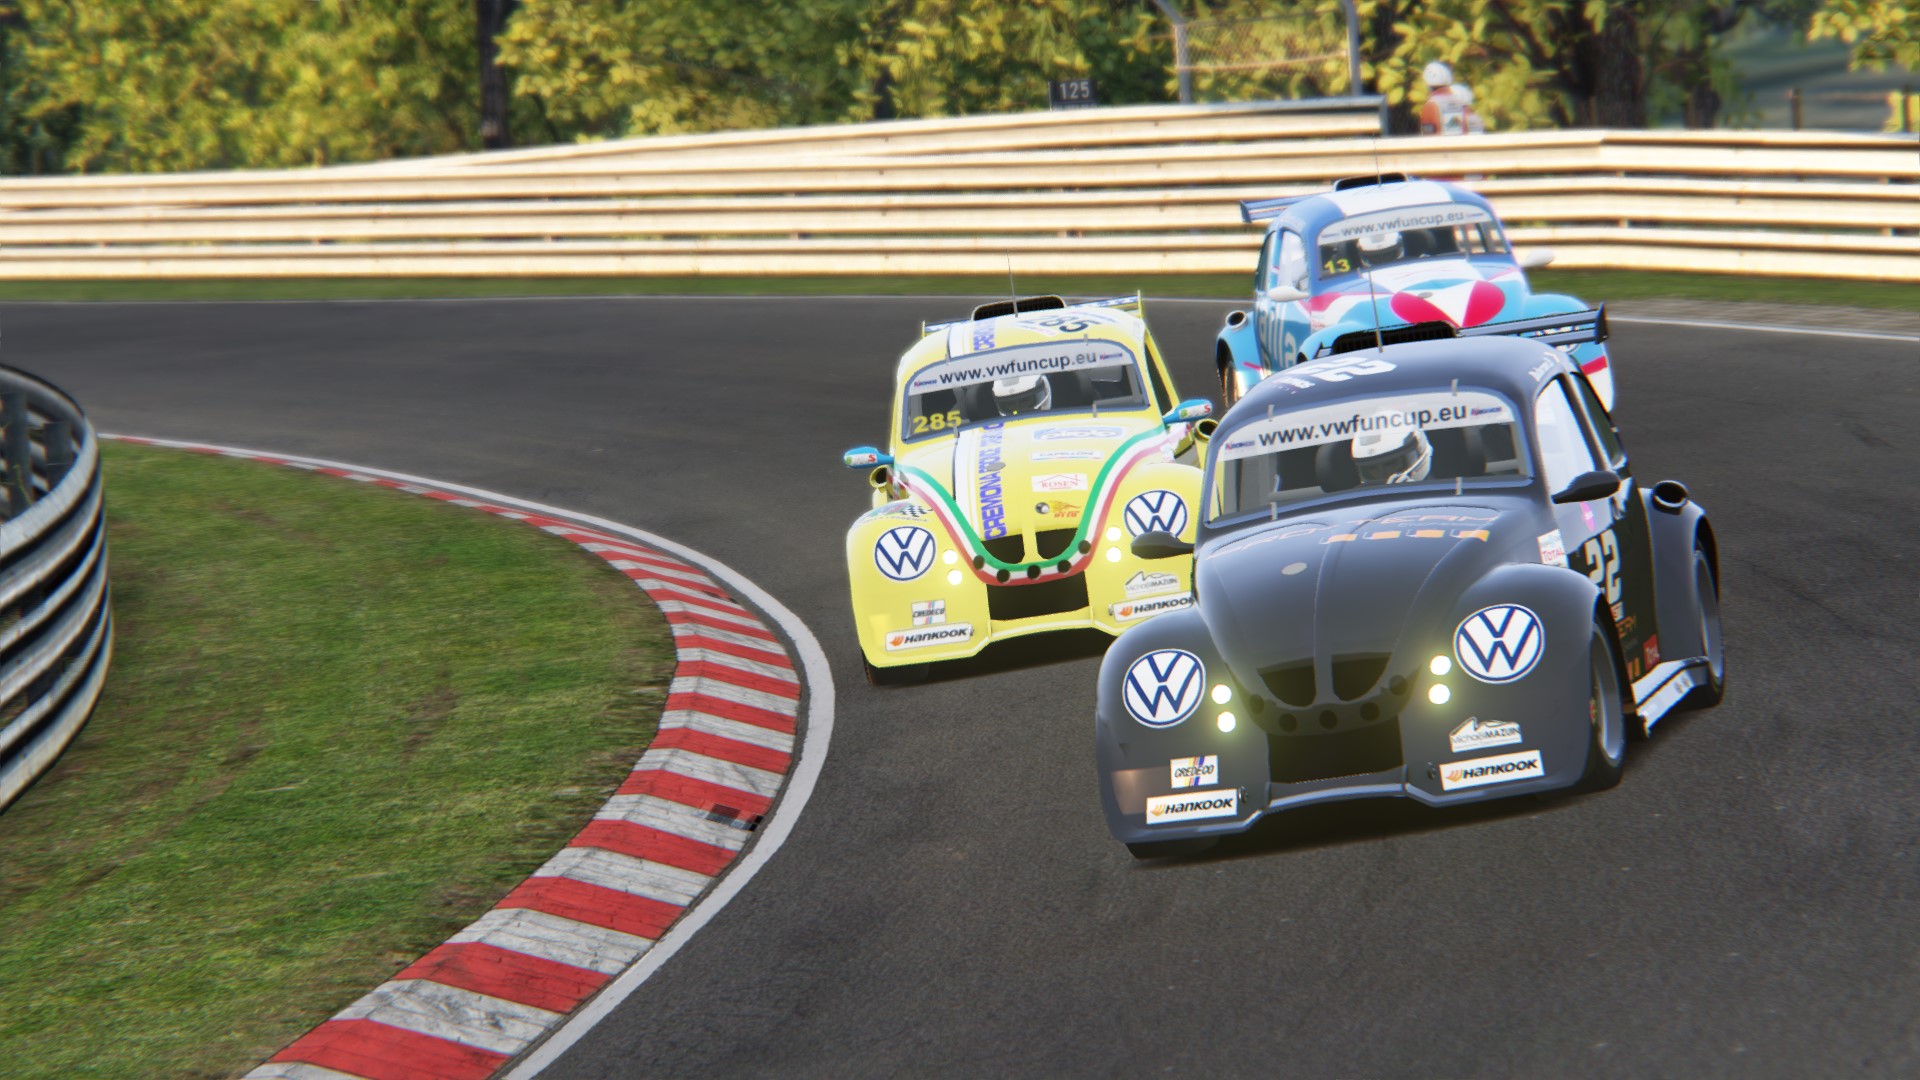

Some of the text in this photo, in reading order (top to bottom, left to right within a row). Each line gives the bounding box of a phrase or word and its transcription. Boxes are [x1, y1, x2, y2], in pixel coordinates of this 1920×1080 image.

[1060, 81, 1090, 100] 125
[1341, 211, 1464, 237] www.vwfuncup.eu
[1324, 259, 1350, 275] 13
[939, 352, 1097, 384] www.vwfuncup.eu
[913, 411, 961, 434] 285
[1258, 405, 1467, 447] www.vwfuncup.eu
[979, 472, 1007, 541] CREMONA
[875, 526, 936, 581] VW
[1583, 528, 1622, 604] 22
[1454, 604, 1545, 684] VW
[1123, 649, 1205, 727] VW
[1174, 765, 1215, 777] CREDECO
